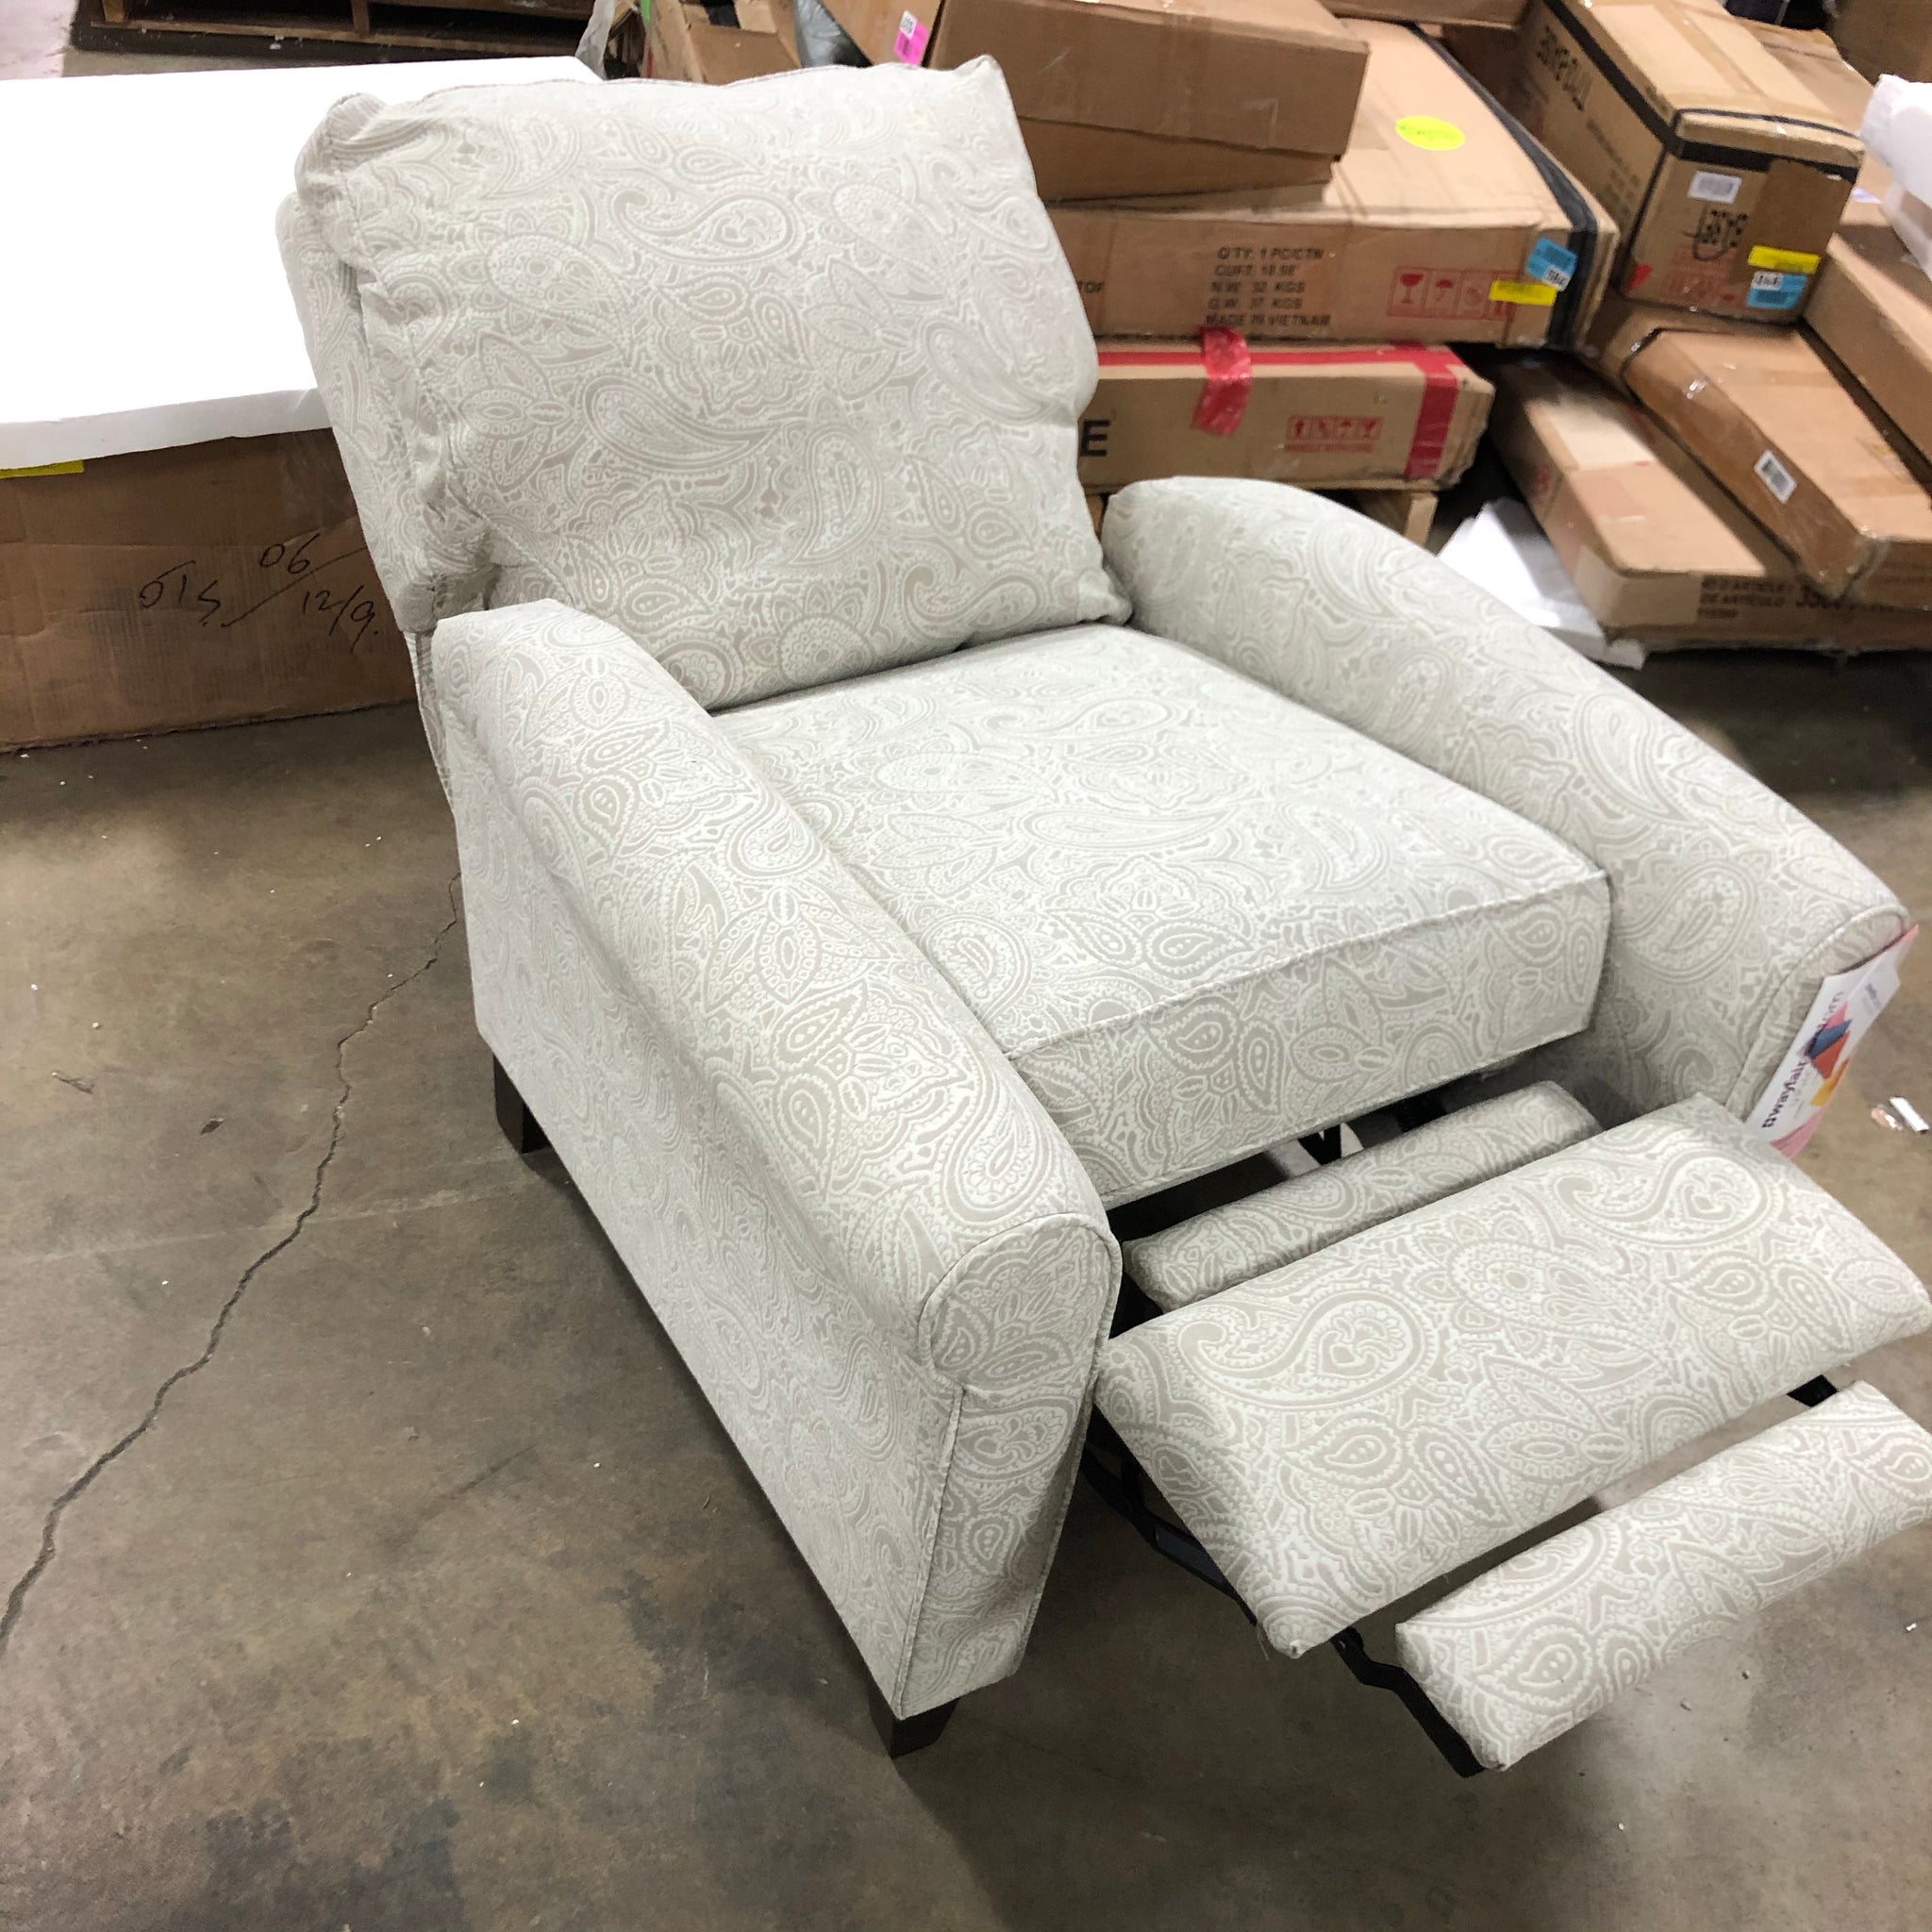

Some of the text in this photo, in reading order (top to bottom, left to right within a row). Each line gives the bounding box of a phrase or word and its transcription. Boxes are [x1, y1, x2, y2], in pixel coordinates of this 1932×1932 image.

[1206, 313, 1331, 326] MADE IN VIETNAM
